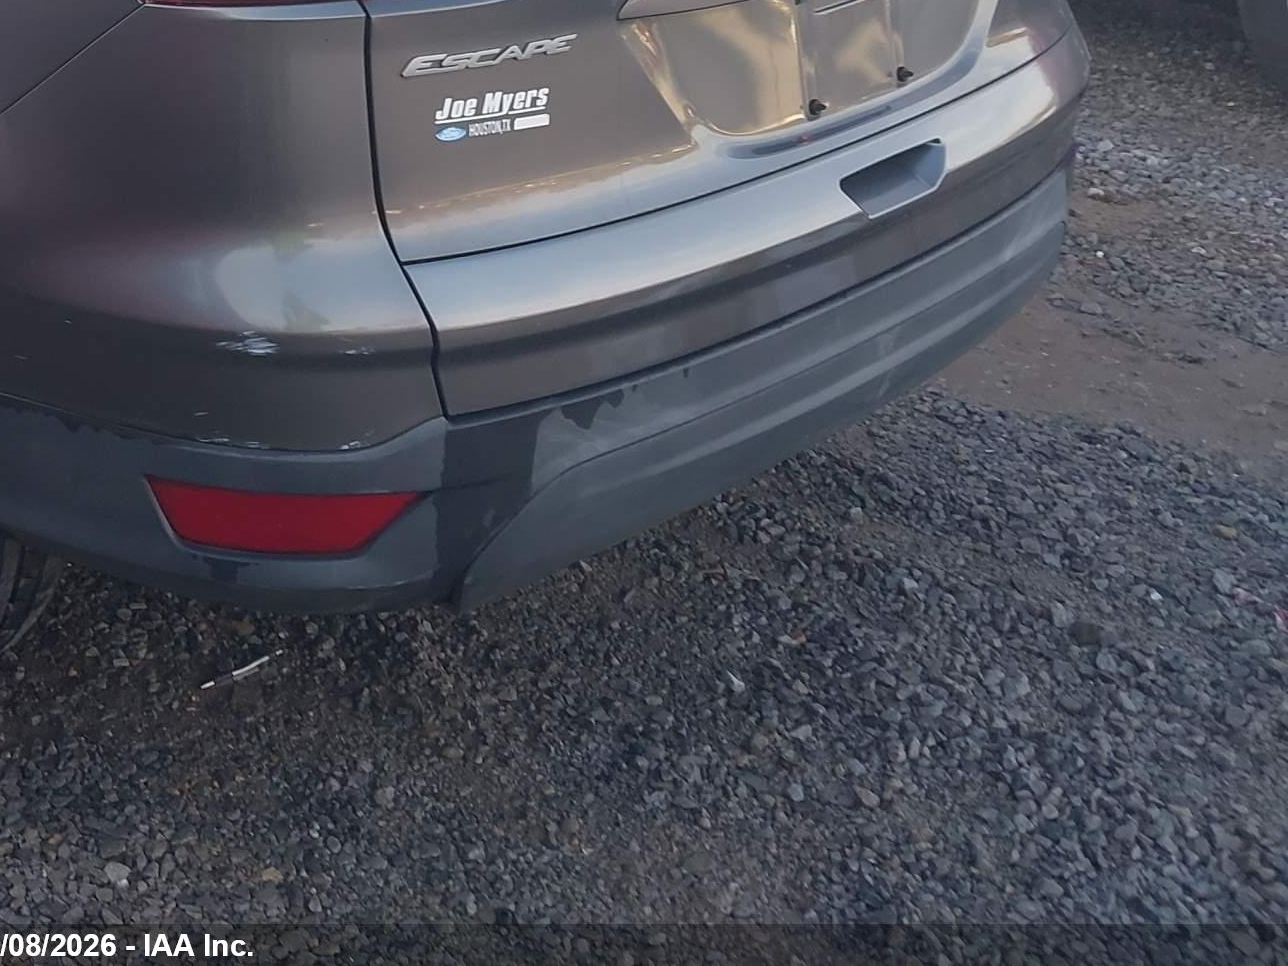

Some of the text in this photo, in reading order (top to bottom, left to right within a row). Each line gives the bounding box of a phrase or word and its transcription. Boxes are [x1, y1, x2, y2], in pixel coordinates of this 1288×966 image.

[402, 34, 577, 77] ESCAPE
[435, 87, 550, 121] Joe Myers
